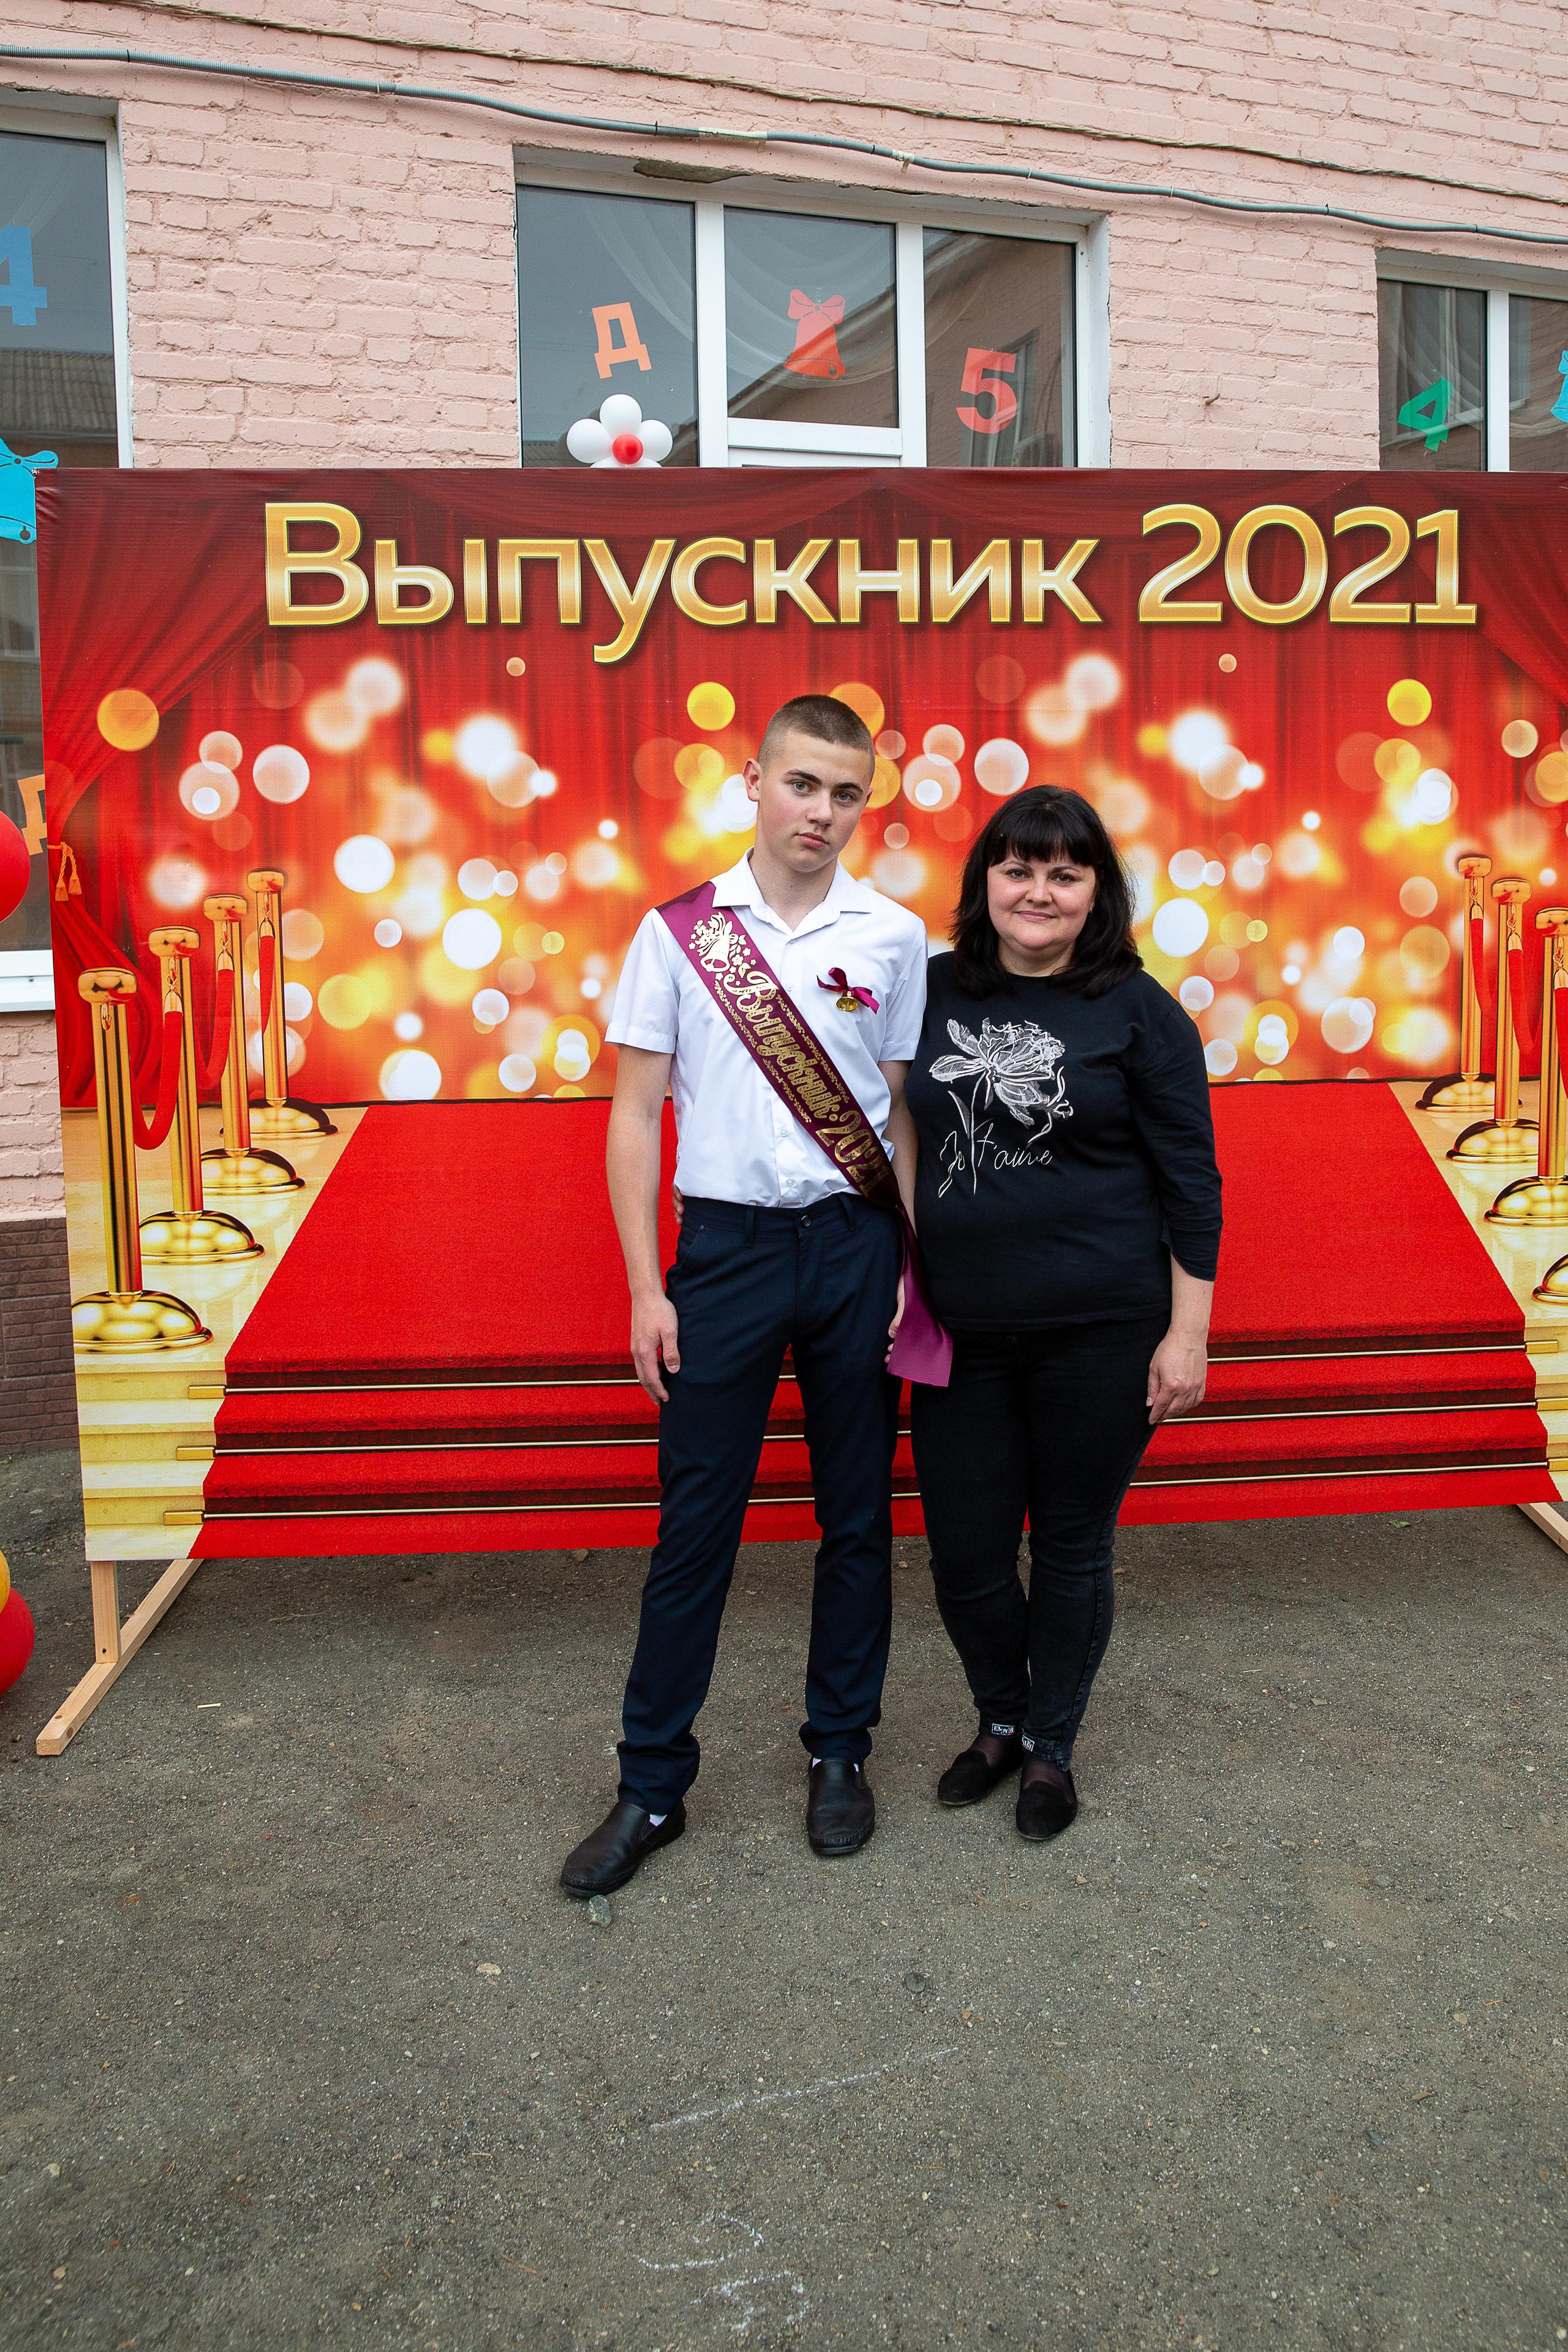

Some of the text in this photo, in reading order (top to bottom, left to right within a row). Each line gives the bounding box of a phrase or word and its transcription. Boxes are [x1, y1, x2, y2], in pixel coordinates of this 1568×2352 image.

[592, 302, 652, 379] Д
[956, 347, 1017, 434] 5
[1397, 378, 1453, 452] 4
[264, 502, 1478, 663] Выпускник 2021
